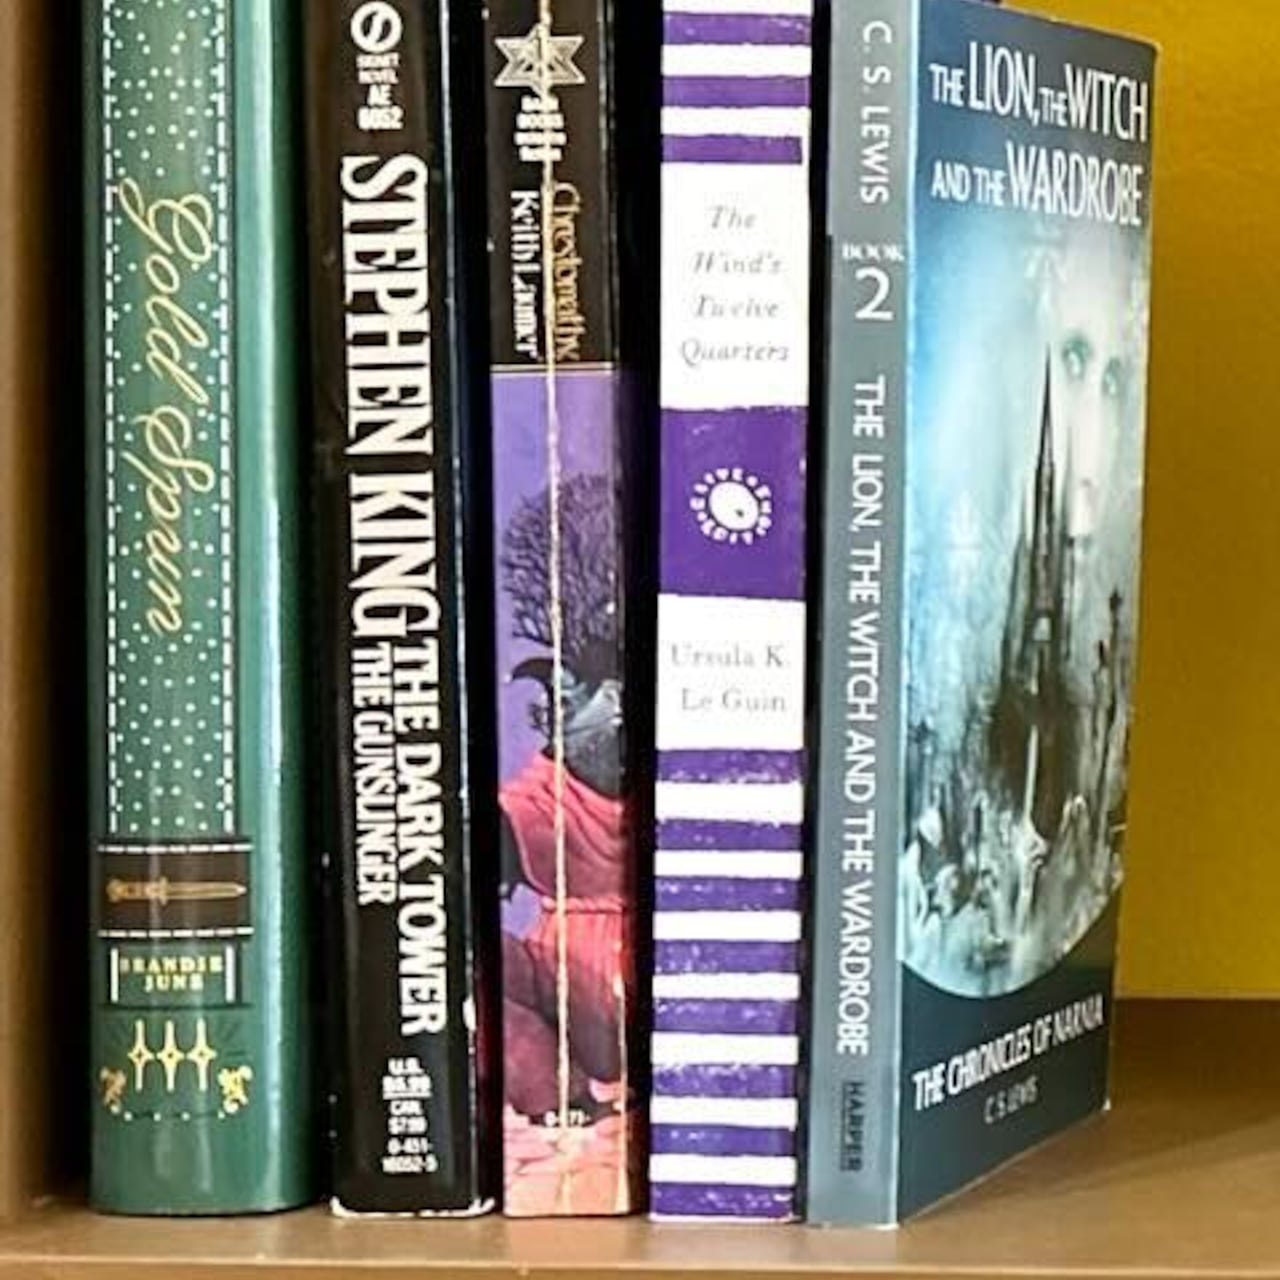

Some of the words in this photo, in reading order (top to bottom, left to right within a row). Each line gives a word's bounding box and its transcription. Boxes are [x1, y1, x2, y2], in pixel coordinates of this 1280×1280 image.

[929, 62, 966, 107] THE
[967, 40, 1039, 126] LION,
[1038, 86, 1068, 126] THE
[1065, 62, 1148, 144] WITCH
[860, 105, 893, 205] LEWIS
[931, 161, 973, 202] AND
[973, 167, 1006, 207] THE
[1004, 141, 1143, 227] WARDROBE
[707, 204, 757, 230] The
[841, 243, 905, 261] BOOK
[117, 177, 214, 404] Gold
[691, 250, 784, 276] Wind's
[853, 268, 894, 322] 2
[341, 155, 433, 458] STEPHEN
[694, 295, 780, 320] Twelve
[680, 338, 791, 367] Quarters
[851, 375, 885, 440] THE
[122, 405, 216, 635] Spun
[848, 451, 885, 533] LION,
[346, 472, 443, 640] KING
[847, 541, 882, 605] THE
[396, 640, 440, 729] THE
[669, 644, 756, 669] Ursula
[844, 613, 880, 720] WITCH
[680, 686, 713, 713] Le
[720, 687, 788, 715] Guin
[351, 708, 397, 906] GUNSLINGER
[842, 729, 878, 805] AND
[396, 734, 444, 884] DARK
[840, 810, 877, 873] THE
[118, 955, 225, 975] BRANDIE
[144, 974, 205, 992] JUNE
[398, 885, 449, 1036] TOWER
[836, 877, 876, 1057] WARDROBE
[911, 1067, 946, 1112] THE
[946, 1032, 1033, 1097] CHRONICLES
[1050, 993, 1104, 1049] NARNIA
